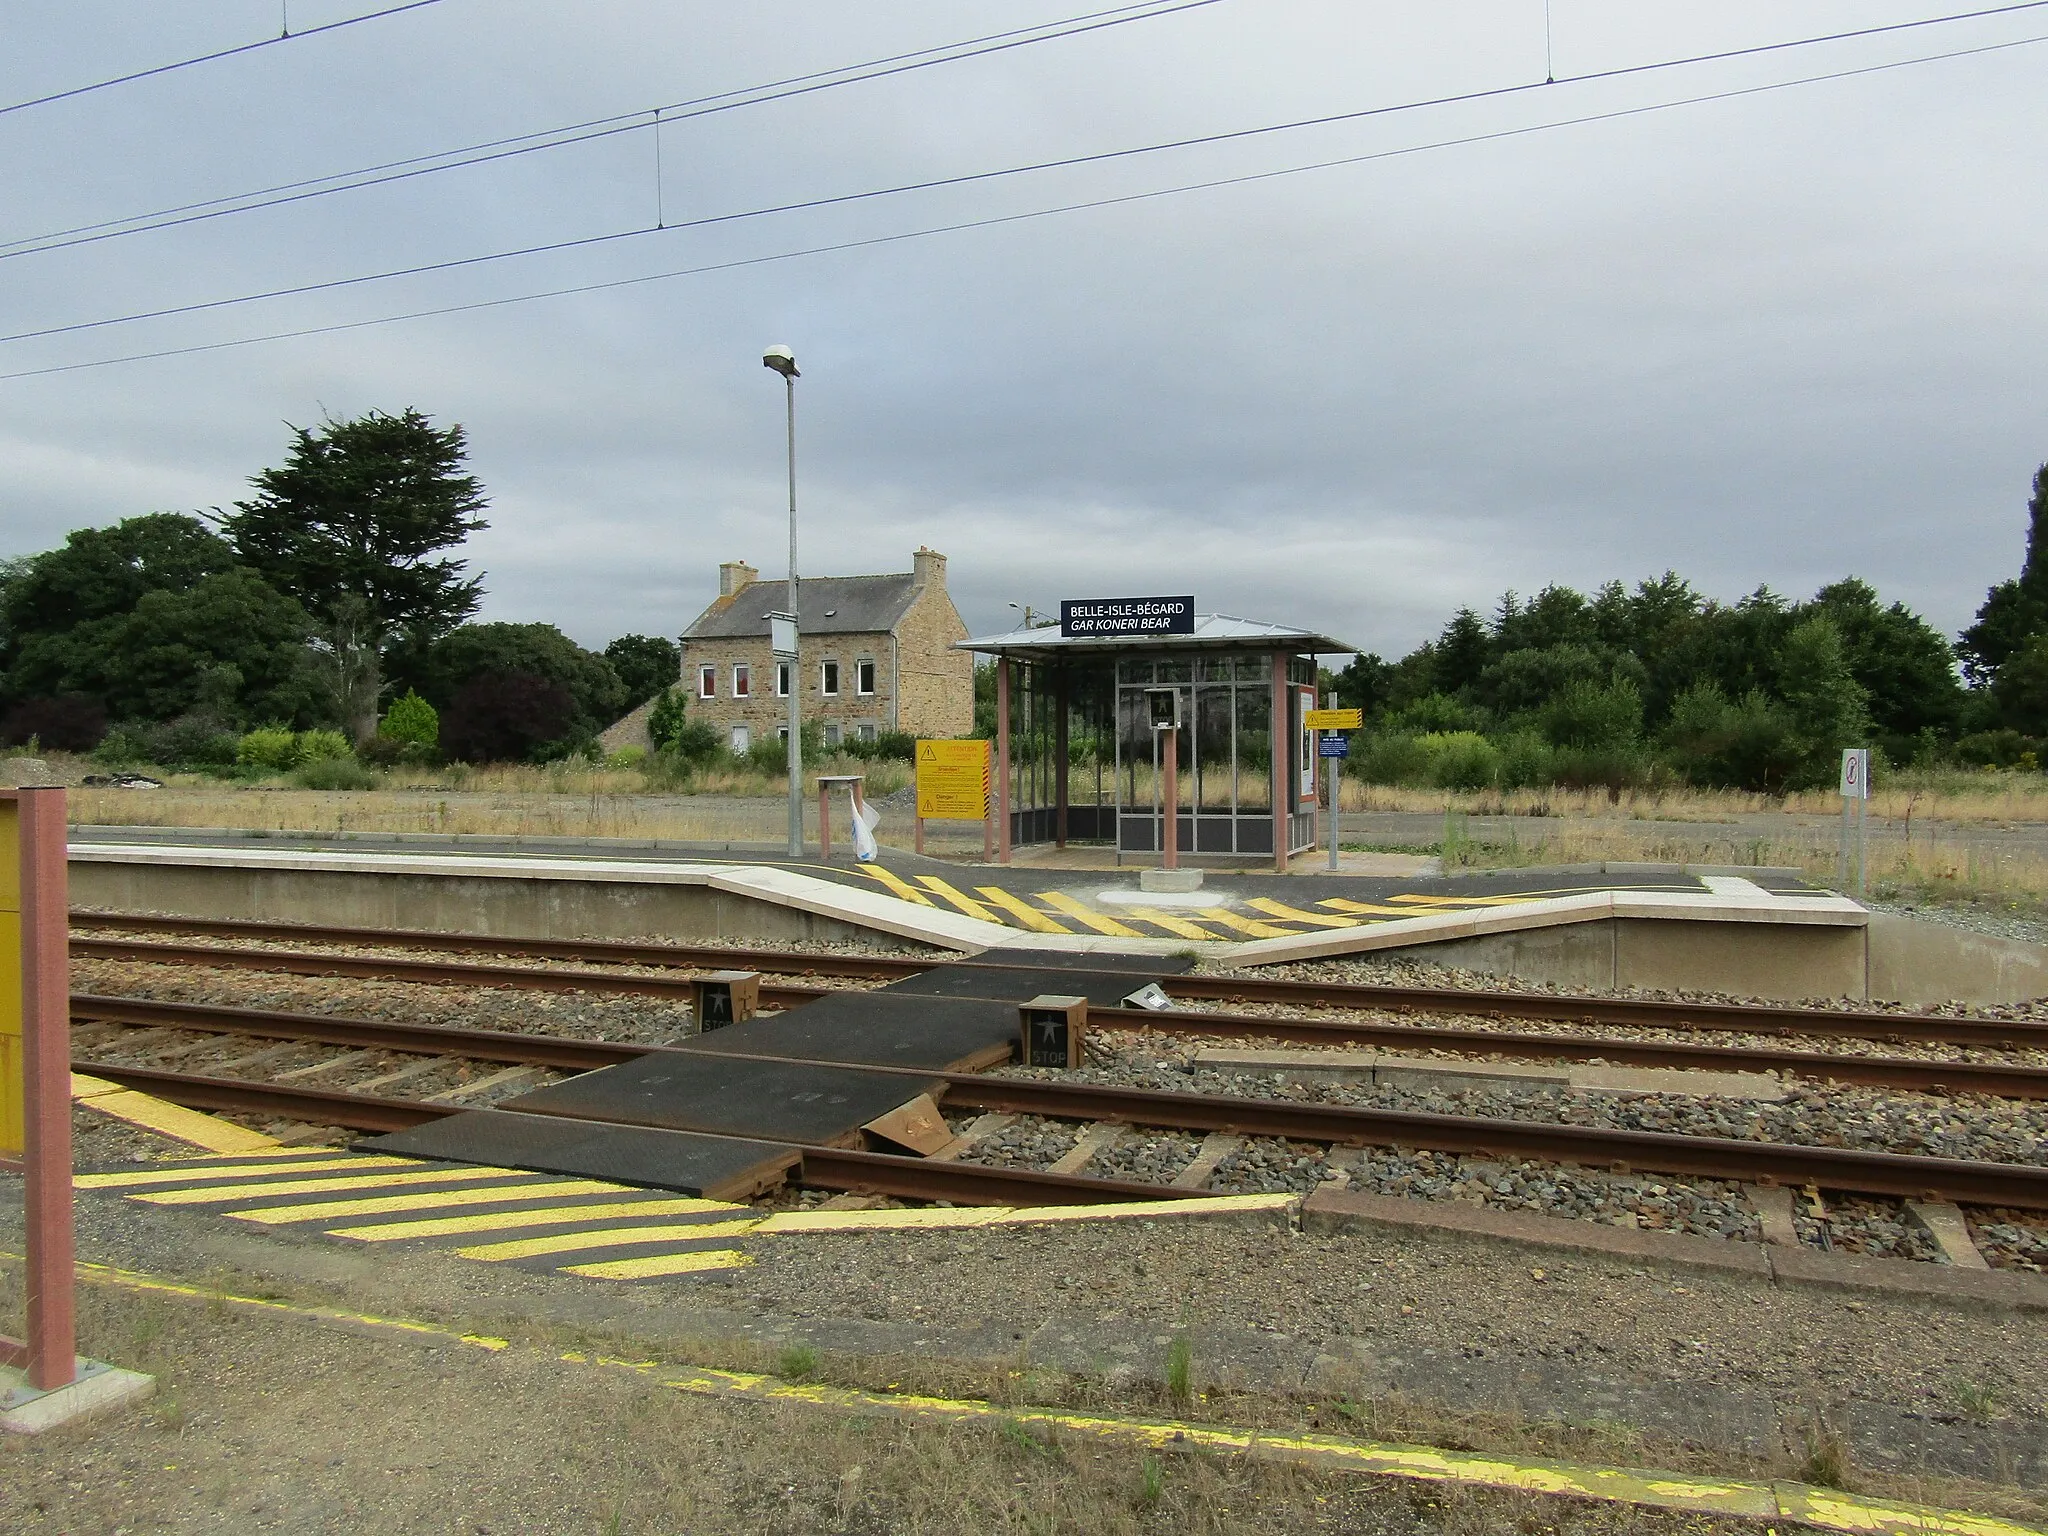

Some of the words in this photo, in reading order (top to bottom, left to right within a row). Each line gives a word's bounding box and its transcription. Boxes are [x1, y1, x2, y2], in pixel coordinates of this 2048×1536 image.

[1070, 602, 1184, 617] BELLE-ISLE-BÉGARD
[1071, 620, 1094, 631] GAR
[1096, 619, 1138, 630] KONERI
[1140, 618, 1171, 629] BEAR
[1032, 1050, 1066, 1065] STOP
